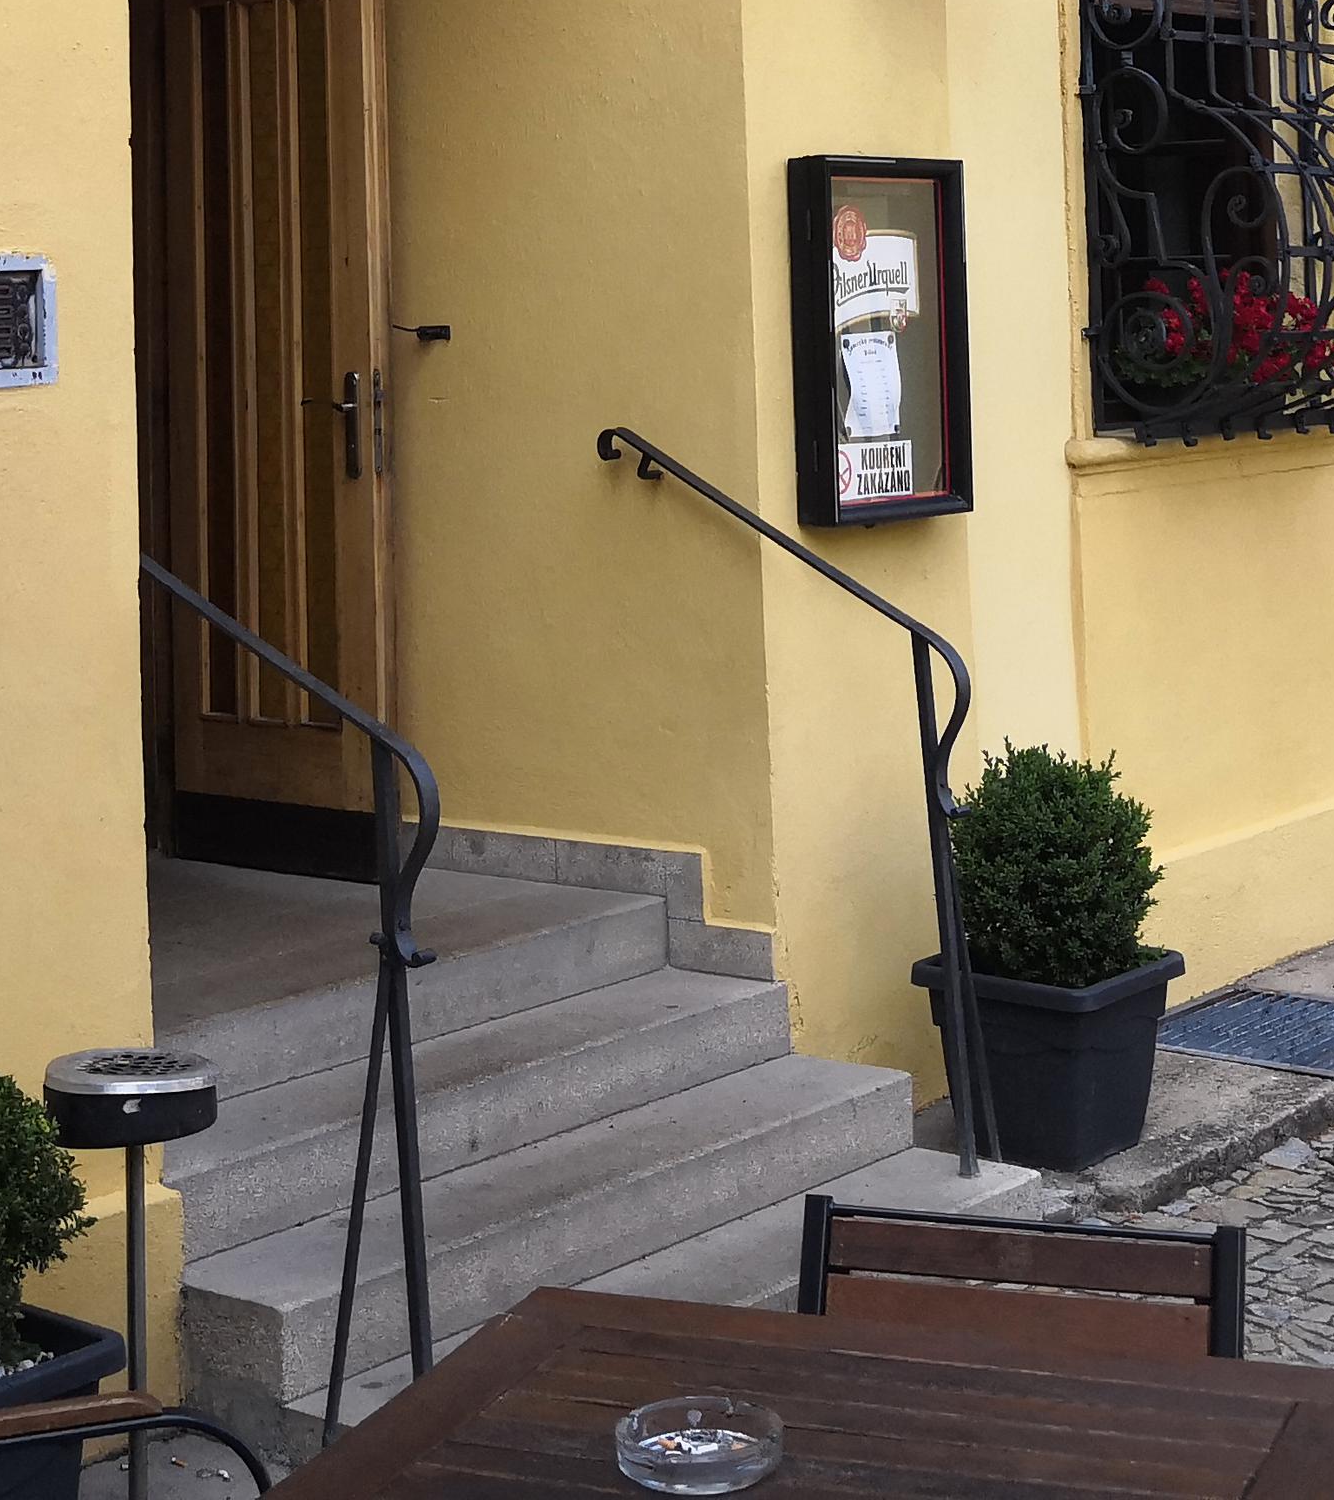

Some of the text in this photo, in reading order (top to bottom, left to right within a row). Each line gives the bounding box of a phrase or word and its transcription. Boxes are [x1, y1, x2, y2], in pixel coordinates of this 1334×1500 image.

[867, 259, 908, 297] Urquell
[861, 443, 906, 470] KOUŘENÍ
[857, 467, 910, 495] ZAKÁZÁNO
